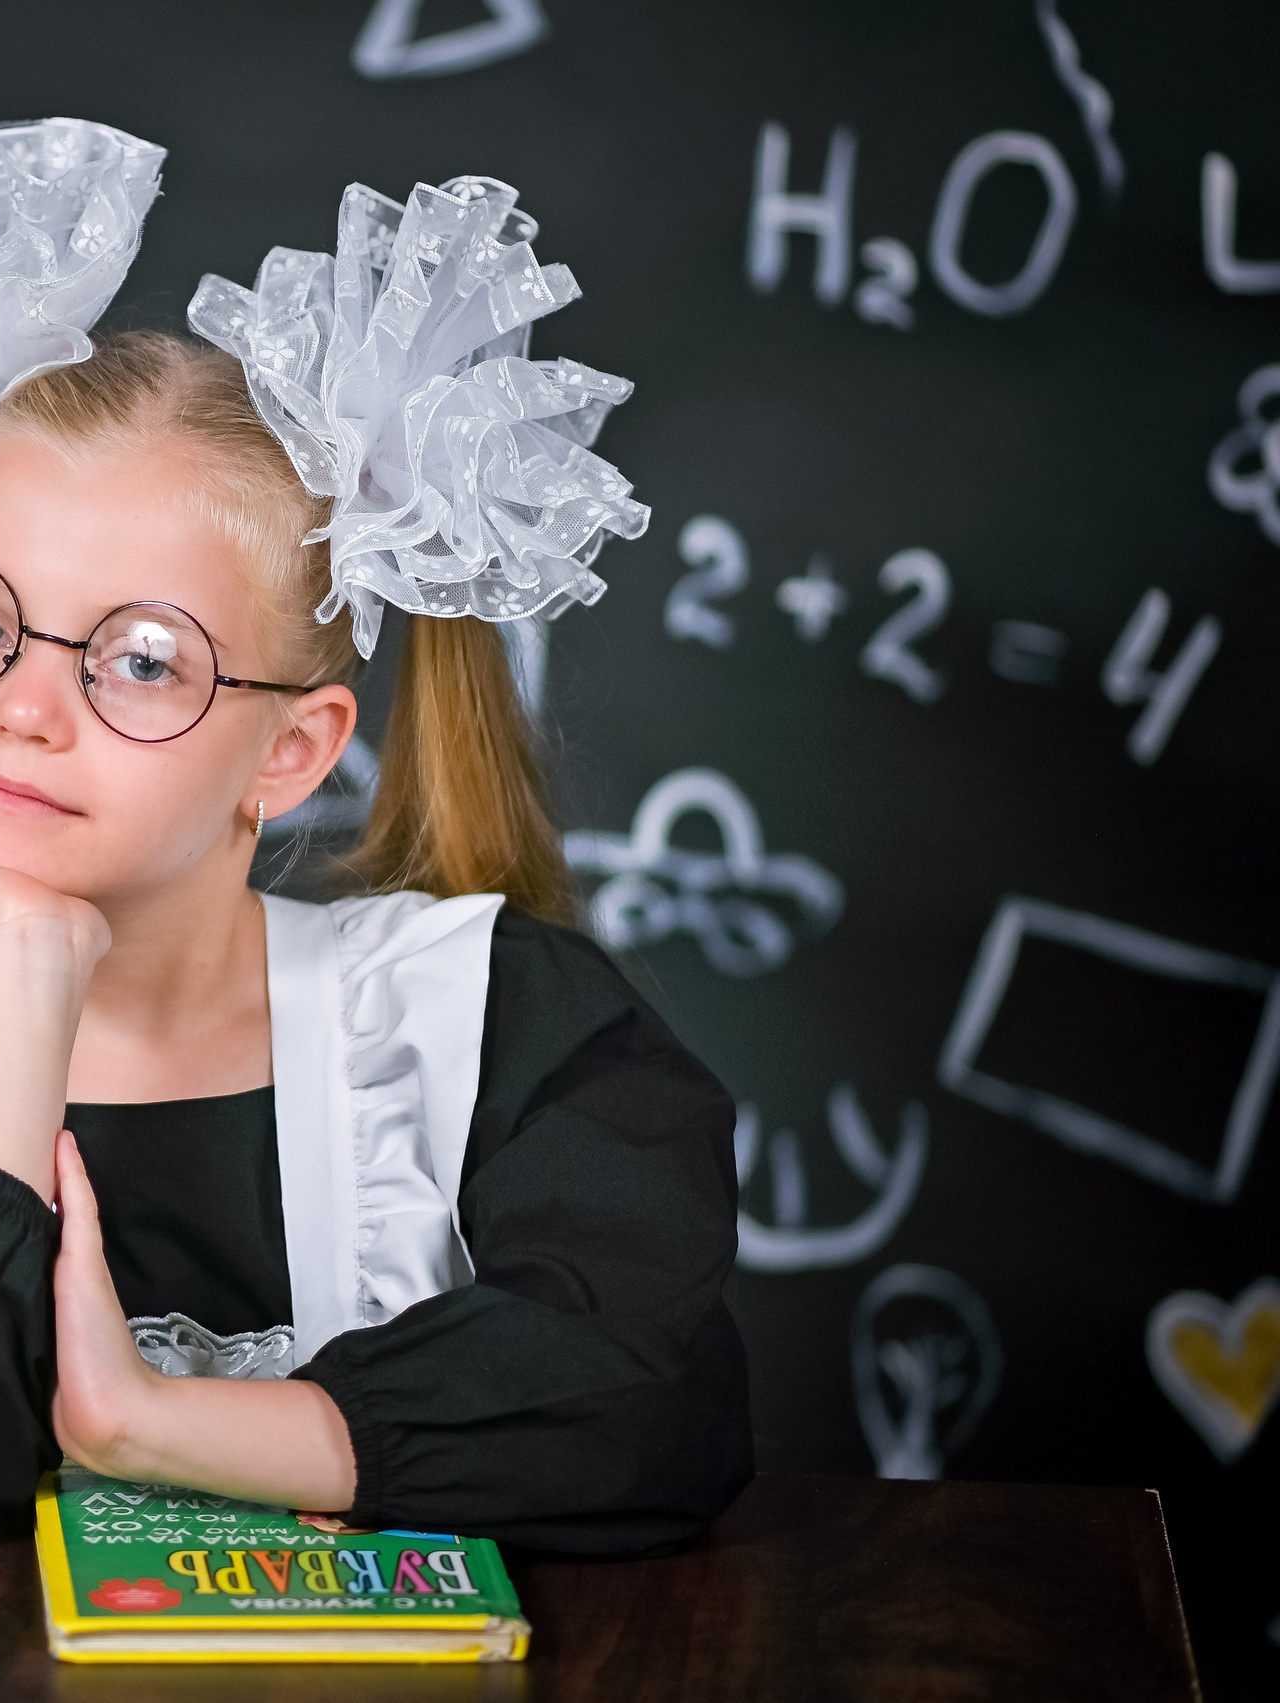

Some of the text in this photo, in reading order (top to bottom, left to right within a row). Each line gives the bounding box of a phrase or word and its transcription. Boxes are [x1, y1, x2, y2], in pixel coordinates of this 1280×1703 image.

[80, 1492, 153, 1506] АУ
[83, 1506, 237, 1522] РО-ЗА СА
[82, 1521, 143, 1531] ОХ
[81, 1535, 336, 1545] МА-МА РА-МА
[167, 1548, 480, 1596] БУКВАРЬ
[228, 1597, 378, 1609] ЖУКОВА
